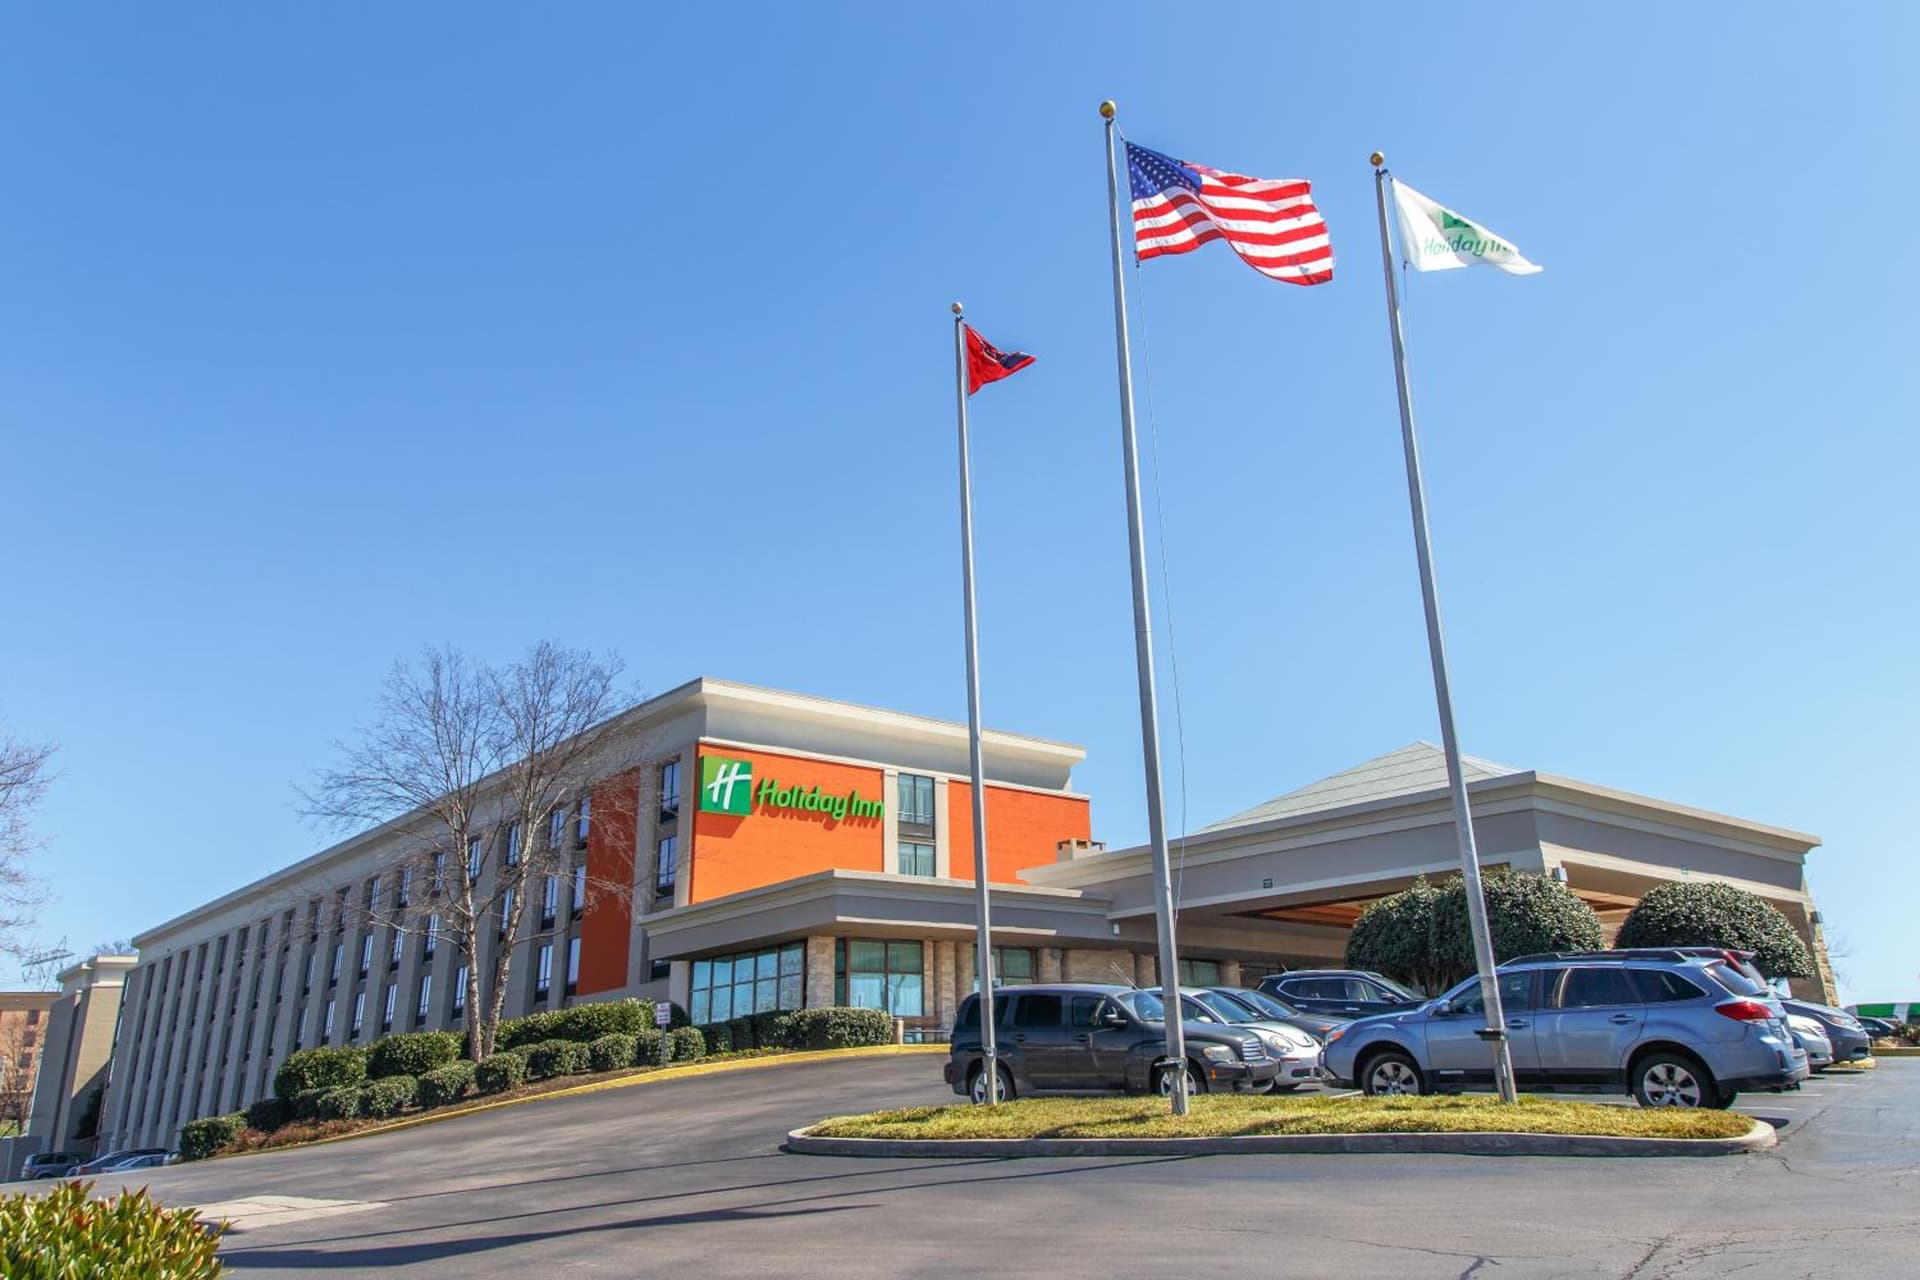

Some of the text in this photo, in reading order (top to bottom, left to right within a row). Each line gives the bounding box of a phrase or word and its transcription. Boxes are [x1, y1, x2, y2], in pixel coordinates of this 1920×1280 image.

[1424, 233, 1487, 257] Holiday
[757, 777, 885, 820] Holiday Inn
